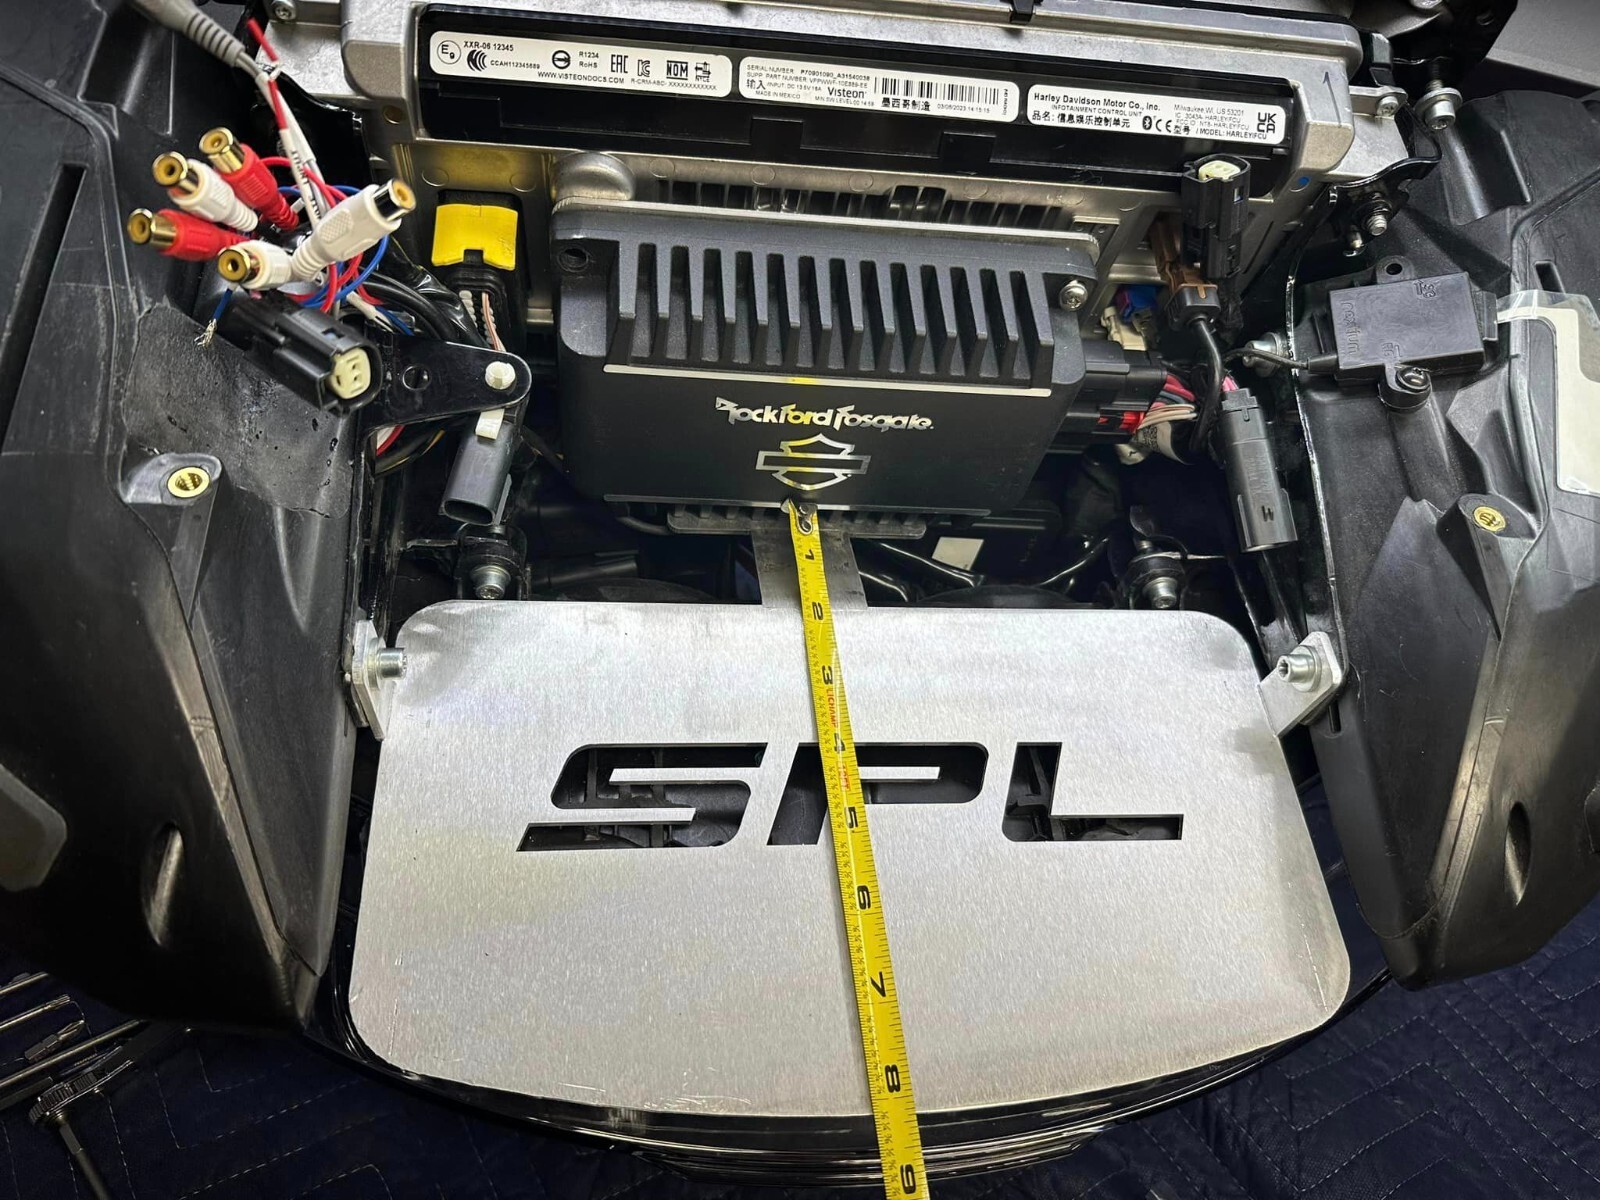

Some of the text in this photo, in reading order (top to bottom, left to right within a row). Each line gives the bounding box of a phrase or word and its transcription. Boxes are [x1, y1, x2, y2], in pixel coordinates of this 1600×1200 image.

[493, 43, 514, 52] 12345
[578, 51, 600, 59] R1234
[579, 61, 598, 69] RoHS
[665, 60, 689, 80] NOM
[747, 64, 767, 72] SERIAL
[537, 71, 625, 84] WWW.VISTEONDOCS.COM
[827, 86, 865, 99] Visteon
[1034, 92, 1060, 103] Harley
[1063, 95, 1100, 106] Davidson
[1103, 98, 1126, 108] Motor
[1146, 102, 1161, 111] Inc.
[1051, 104, 1143, 118] INFOTAINMENT CONTROL UNIT
[715, 396, 935, 432] Rockford Fosgate
[804, 549, 815, 561] 1
[812, 601, 824, 621] 2
[821, 665, 833, 685] 3
[834, 732, 846, 755] 4
[516, 741, 1184, 853] SPL
[844, 806, 859, 829] 5
[857, 885, 871, 910] 6
[870, 971, 887, 997] 7
[885, 1064, 901, 1093] 8
[900, 1164, 917, 1195] 9
